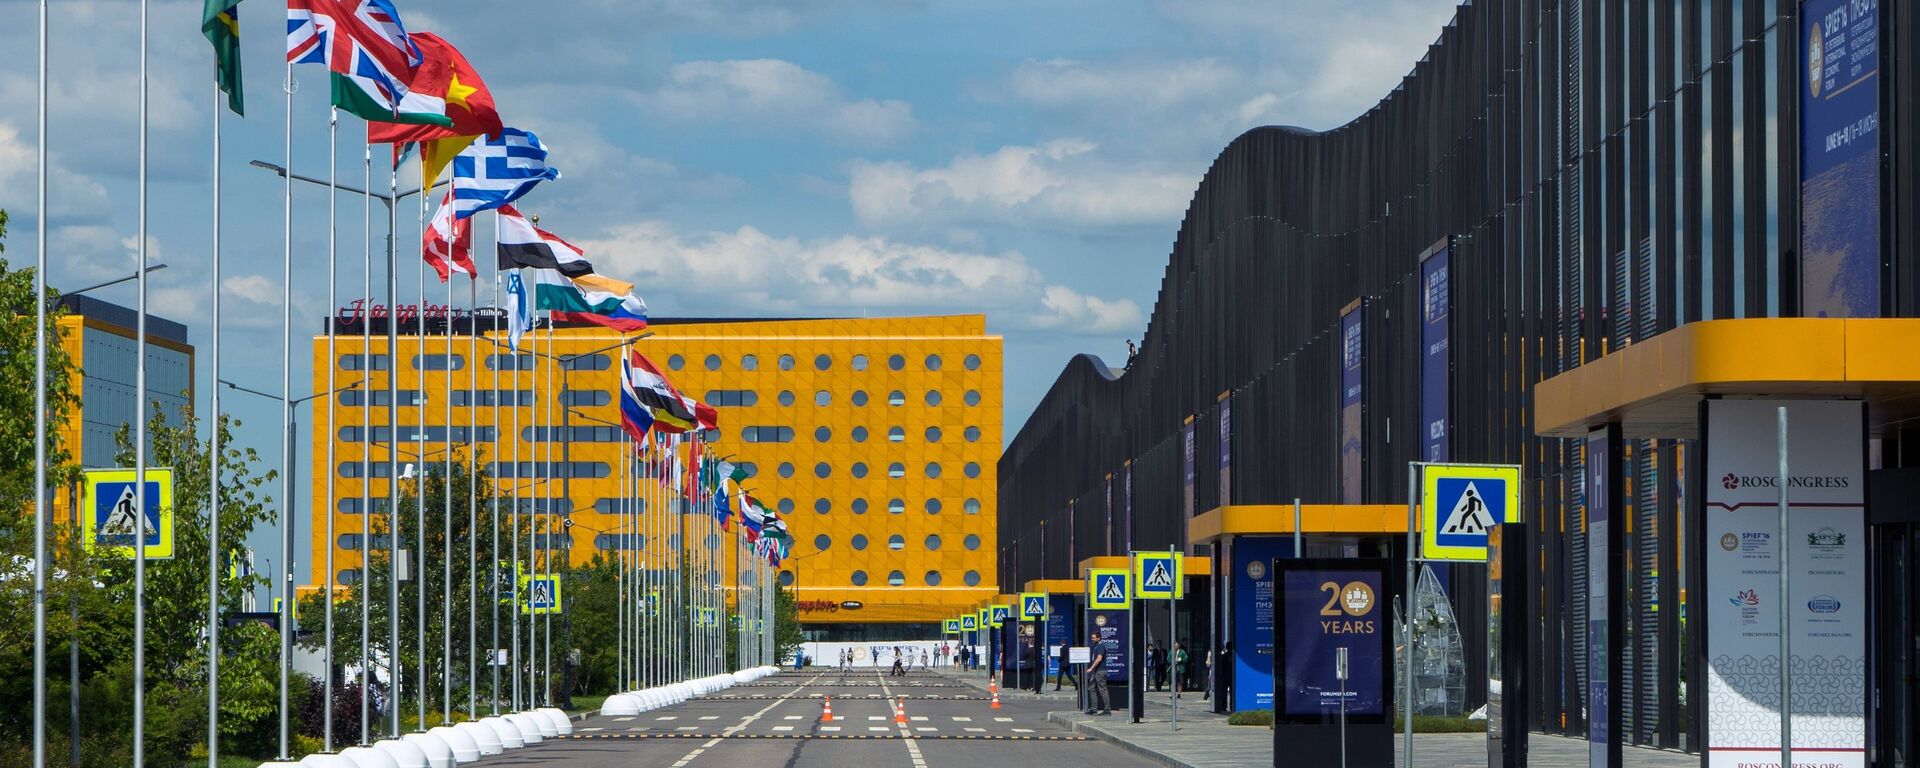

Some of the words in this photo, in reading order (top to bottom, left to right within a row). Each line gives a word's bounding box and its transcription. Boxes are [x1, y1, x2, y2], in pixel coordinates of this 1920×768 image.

[1825, 4, 1847, 38] SPIEF'16
[339, 297, 461, 326] Hampon
[1321, 621, 1375, 634] YEARS
